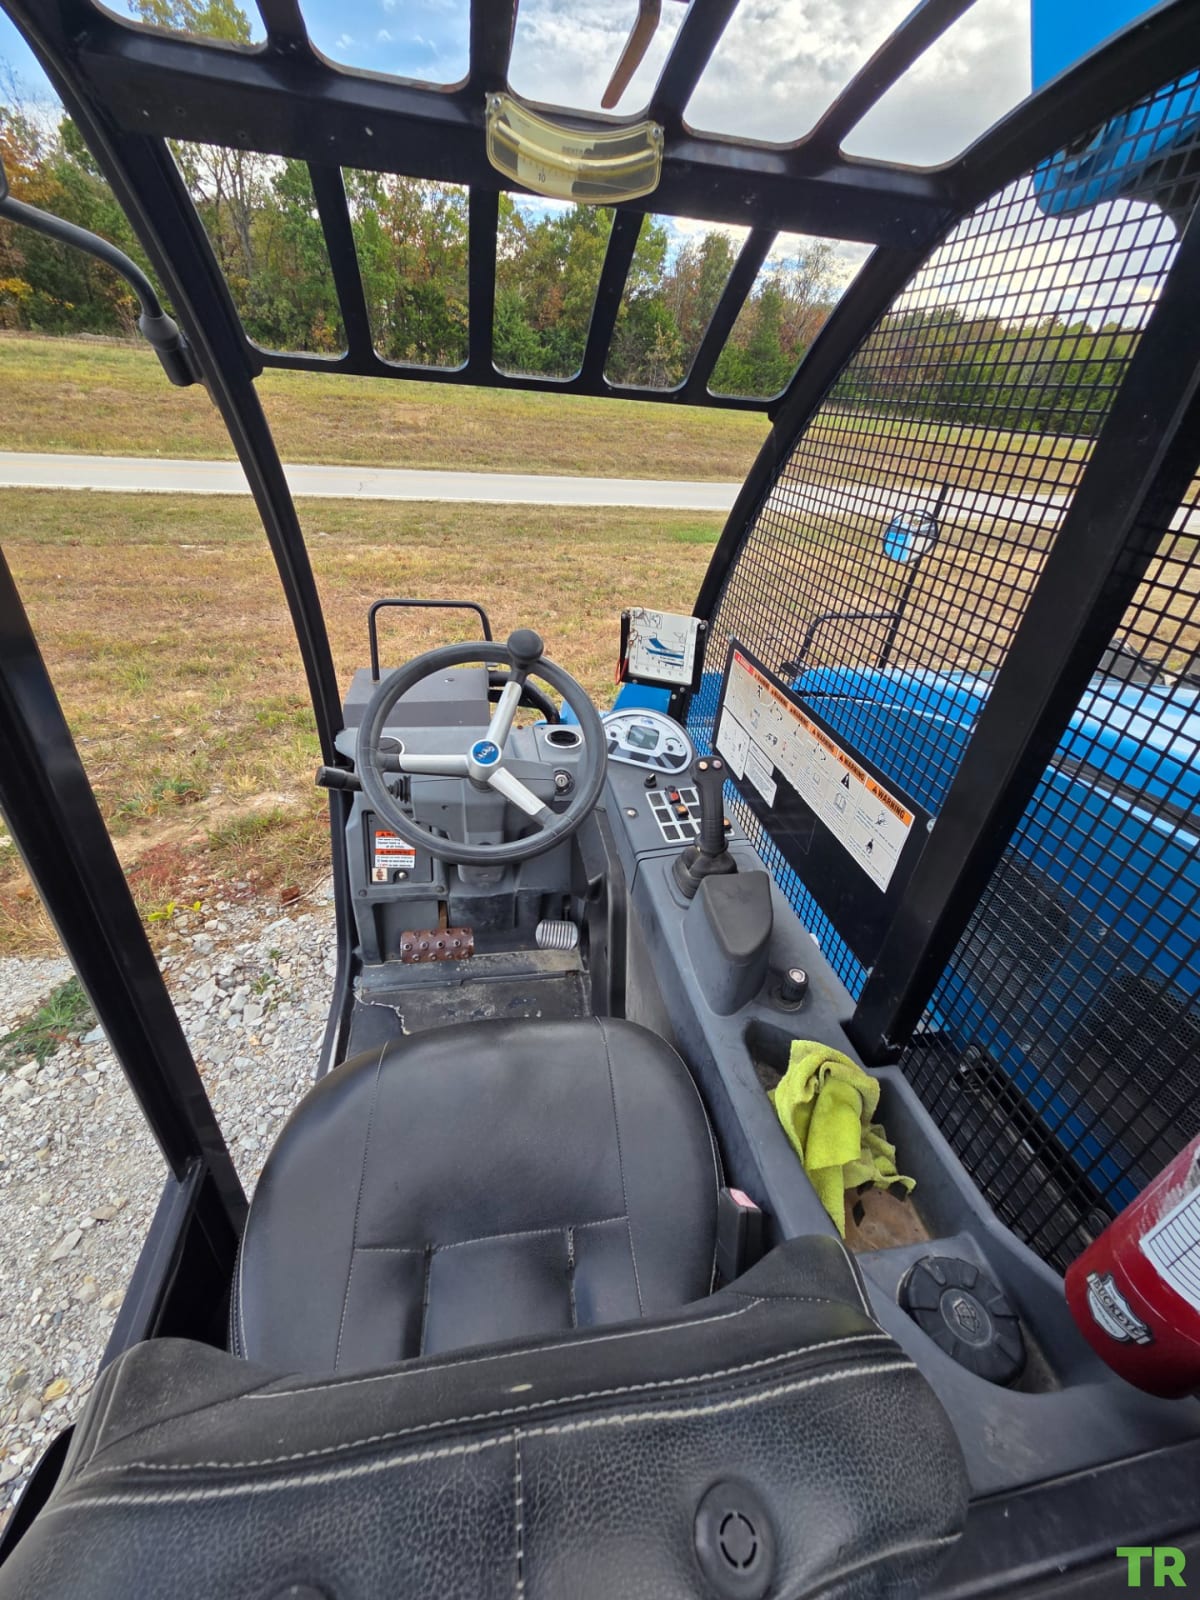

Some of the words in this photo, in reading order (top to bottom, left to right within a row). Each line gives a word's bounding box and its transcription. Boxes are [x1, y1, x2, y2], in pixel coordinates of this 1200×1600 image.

[843, 758, 866, 782] WARNING
[877, 790, 906, 820] WARNING
[1093, 1279, 1147, 1336] BUCKEYE
